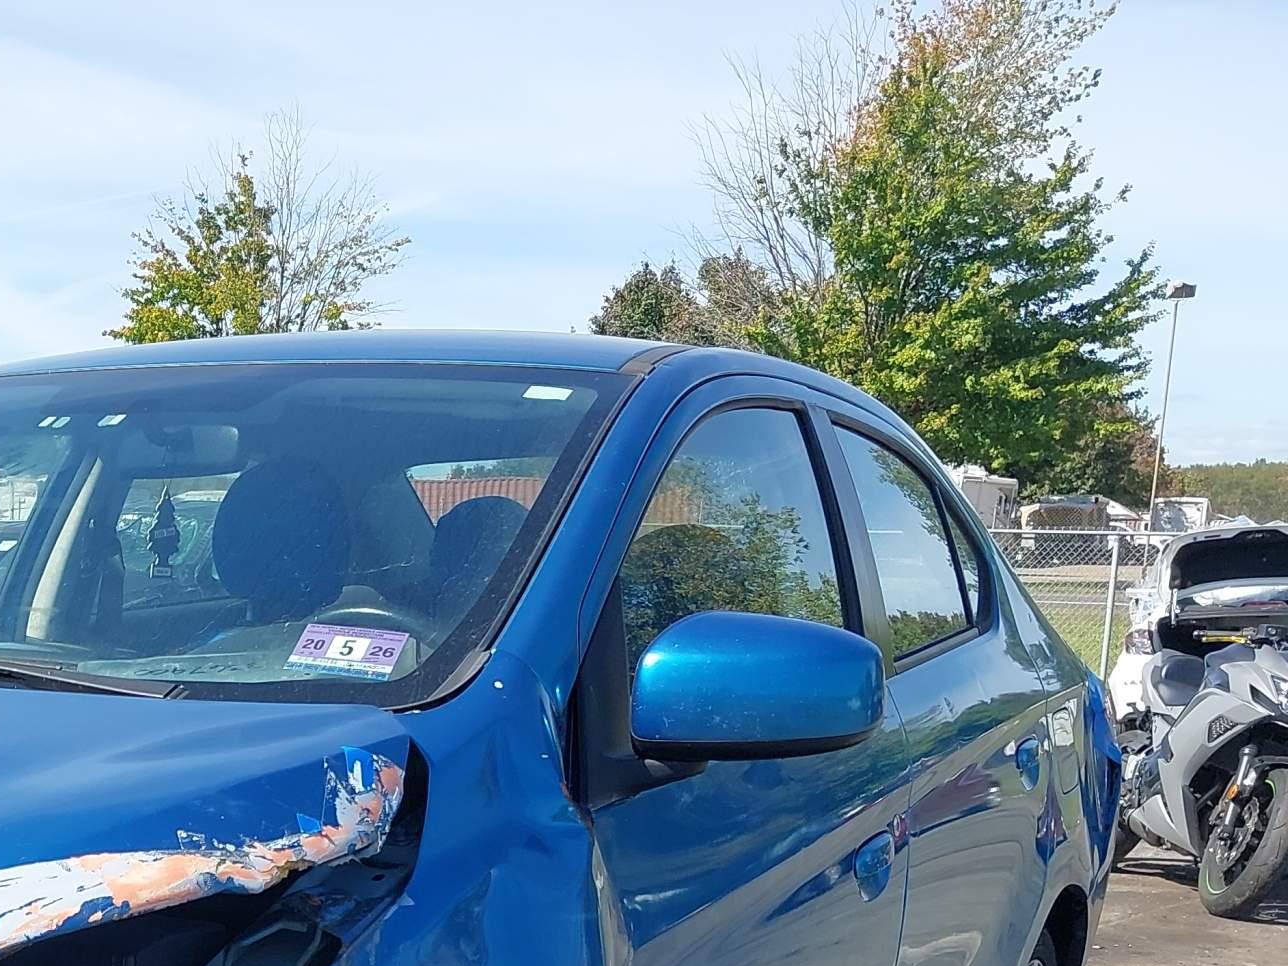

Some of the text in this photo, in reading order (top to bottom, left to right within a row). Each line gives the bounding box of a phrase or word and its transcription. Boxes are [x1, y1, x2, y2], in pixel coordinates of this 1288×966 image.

[302, 638, 396, 658] 20 5 26
